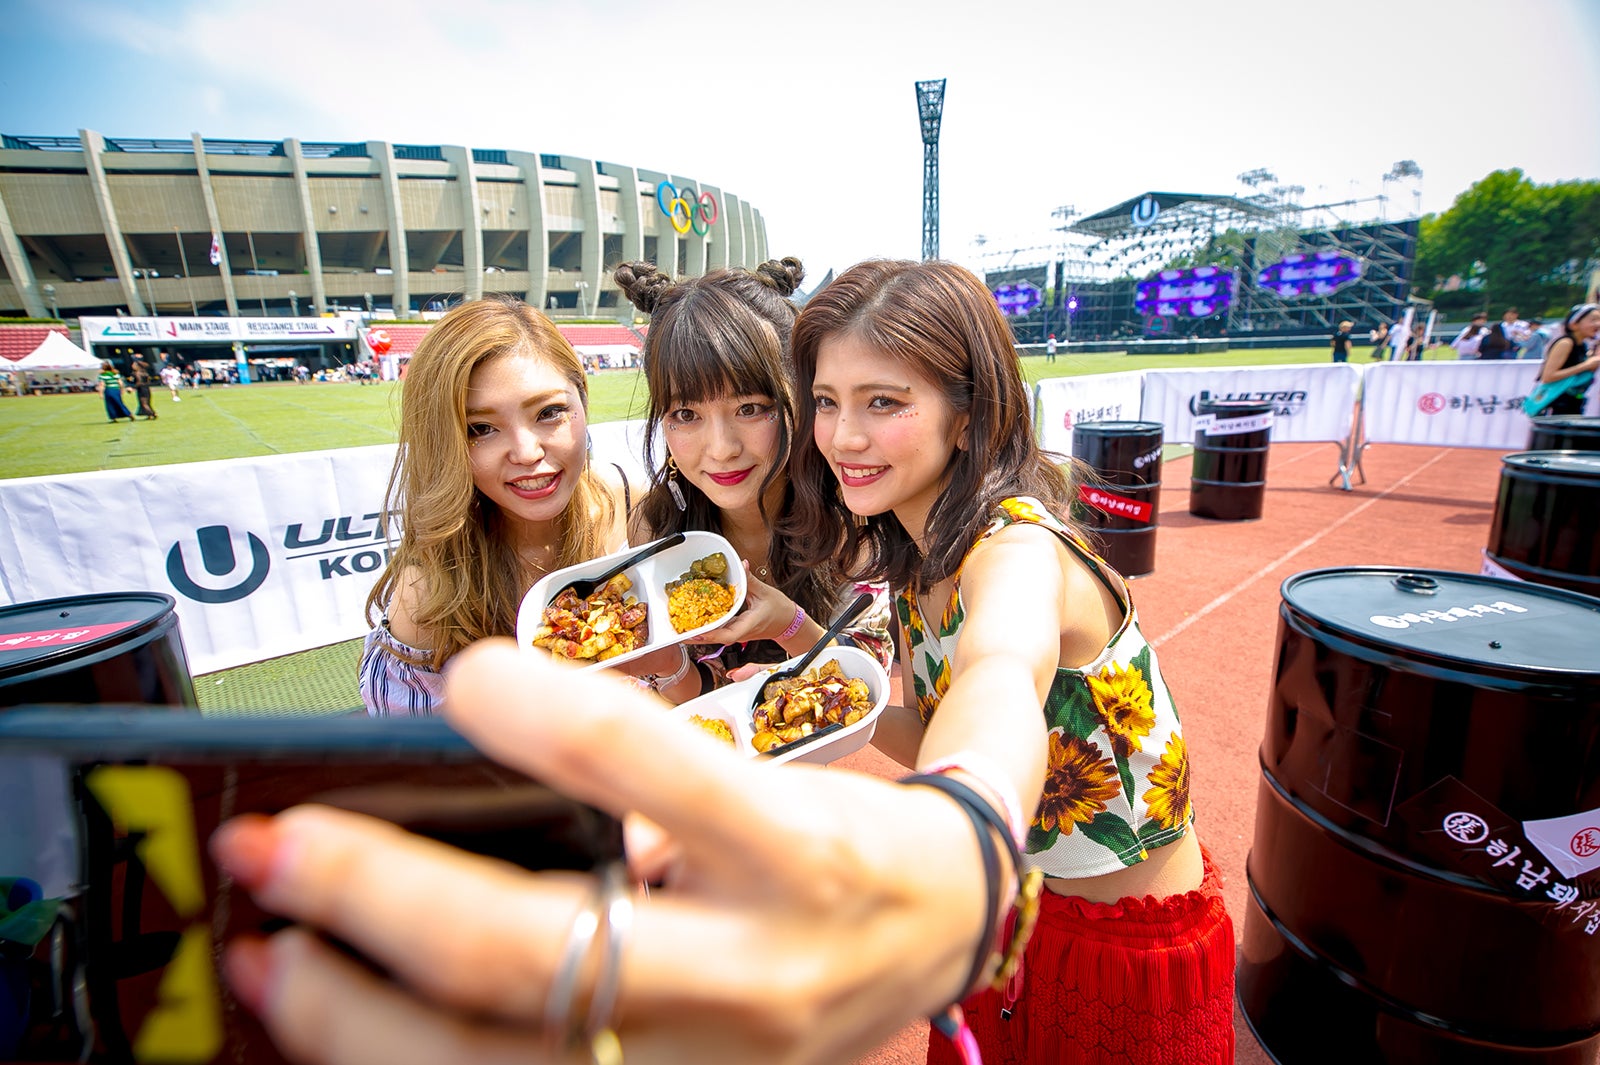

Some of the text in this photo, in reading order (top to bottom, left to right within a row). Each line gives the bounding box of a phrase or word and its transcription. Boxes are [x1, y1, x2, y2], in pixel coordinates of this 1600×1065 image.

[119, 321, 151, 332] TOILET
[179, 322, 231, 331] MAIN STAGE
[247, 322, 319, 331] RESISTANCE STAGE
[283, 509, 405, 550] ULT
